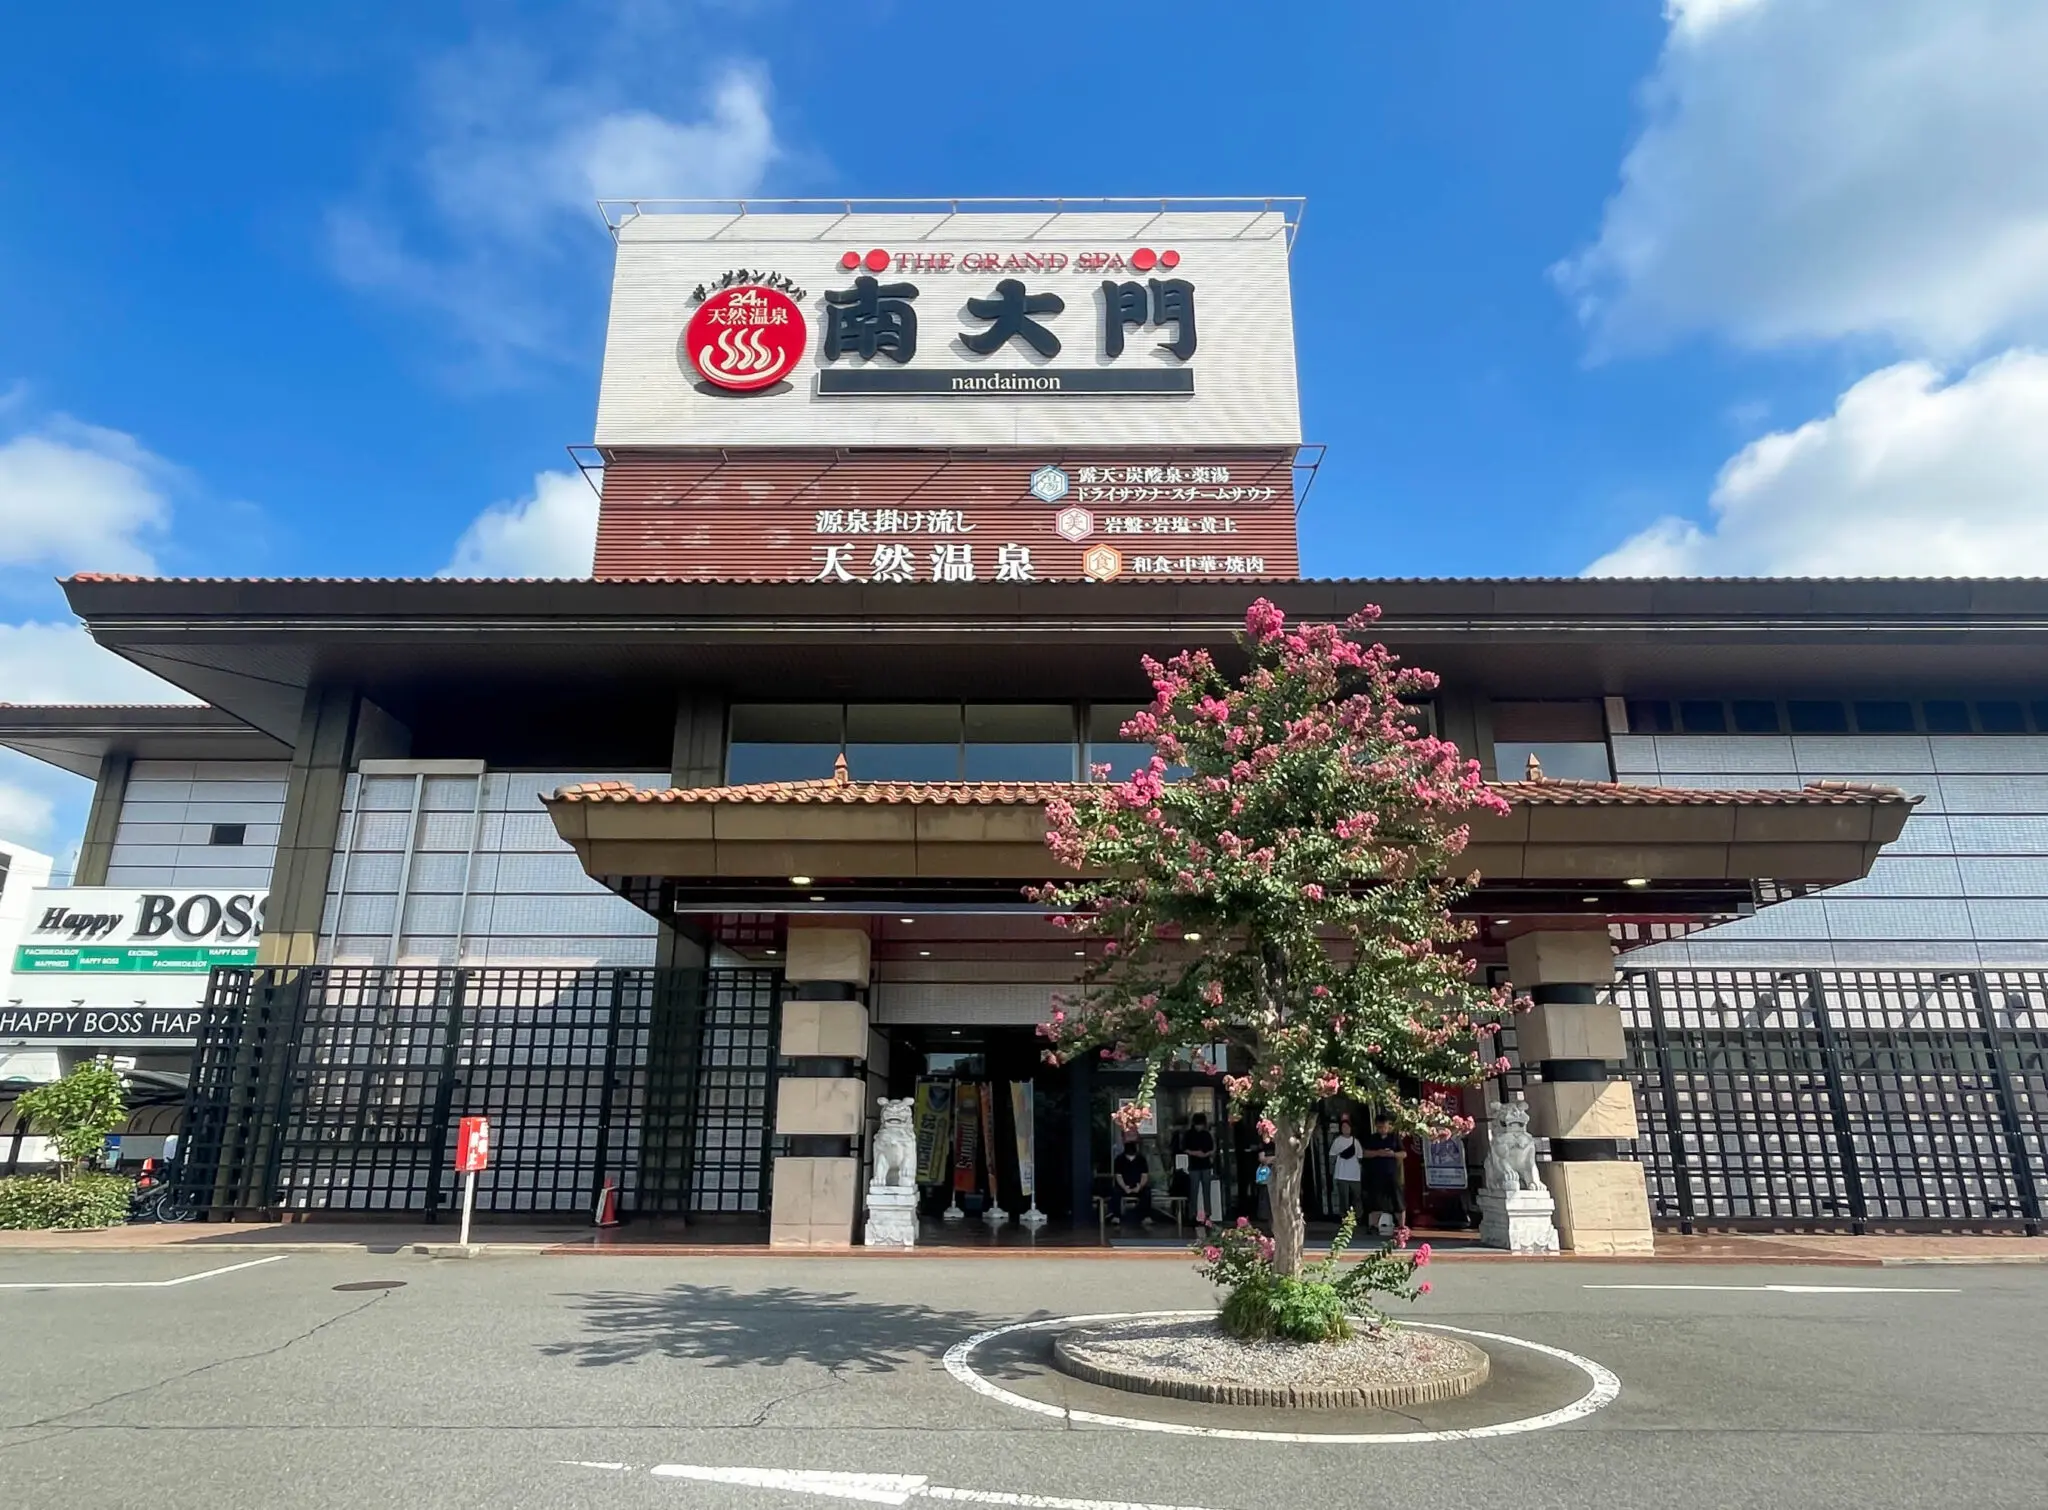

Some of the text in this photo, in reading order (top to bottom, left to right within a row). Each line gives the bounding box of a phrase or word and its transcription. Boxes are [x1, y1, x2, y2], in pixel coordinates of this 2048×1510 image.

[895, 251, 1128, 270] THE GRAND SPA
[728, 289, 768, 307] 24H
[706, 307, 789, 325] 天然温泉
[824, 275, 1198, 363] 南大門
[952, 373, 1061, 391] nandaimon
[1077, 486, 1277, 502] ドライサウナ・スチームサウナ
[815, 508, 977, 533] 源泉掛け流し
[805, 542, 1038, 583] 天然温泉
[1131, 555, 1265, 574] 和食・中華・焼肉
[36, 906, 124, 936] Happy
[0, 1012, 80, 1033] HAPPY
[84, 1012, 144, 1033] BOSS
